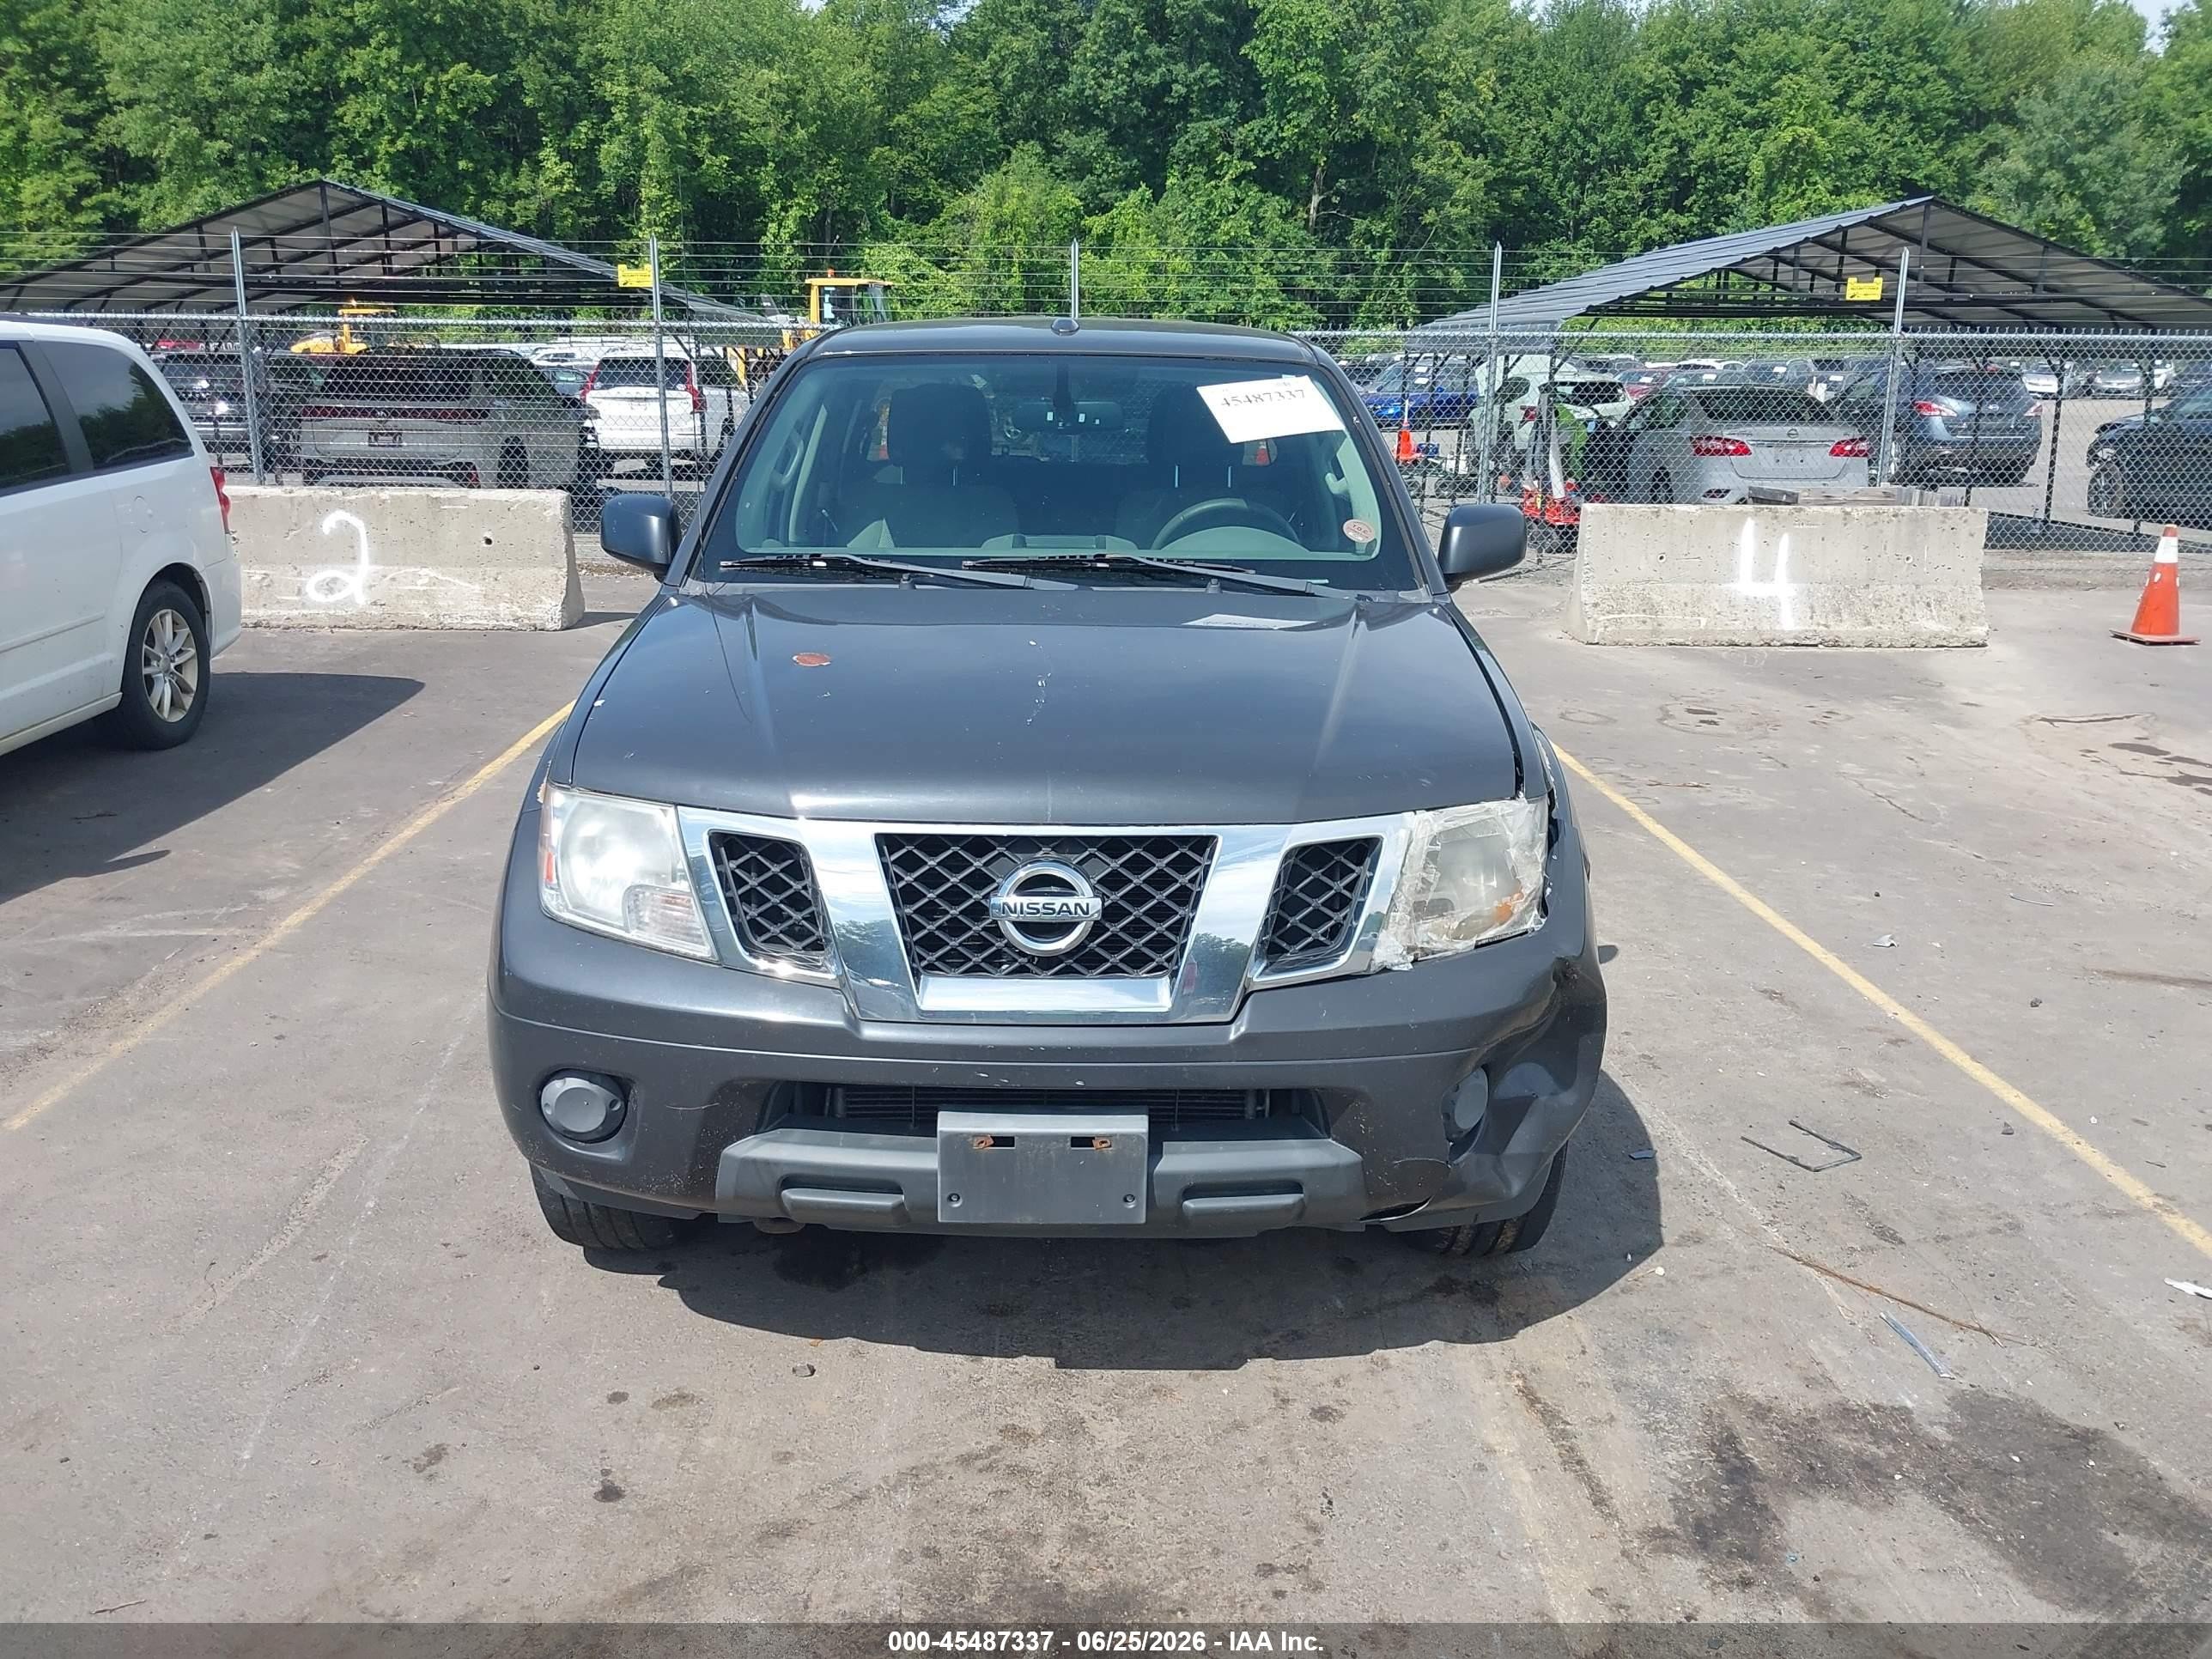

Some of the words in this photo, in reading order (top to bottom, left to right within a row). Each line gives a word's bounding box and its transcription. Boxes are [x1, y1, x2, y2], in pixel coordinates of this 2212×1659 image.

[1221, 389, 1305, 407] 45487337
[306, 509, 369, 605] 2
[1735, 517, 1798, 630] 4
[1001, 902, 1091, 916] NISSAN
